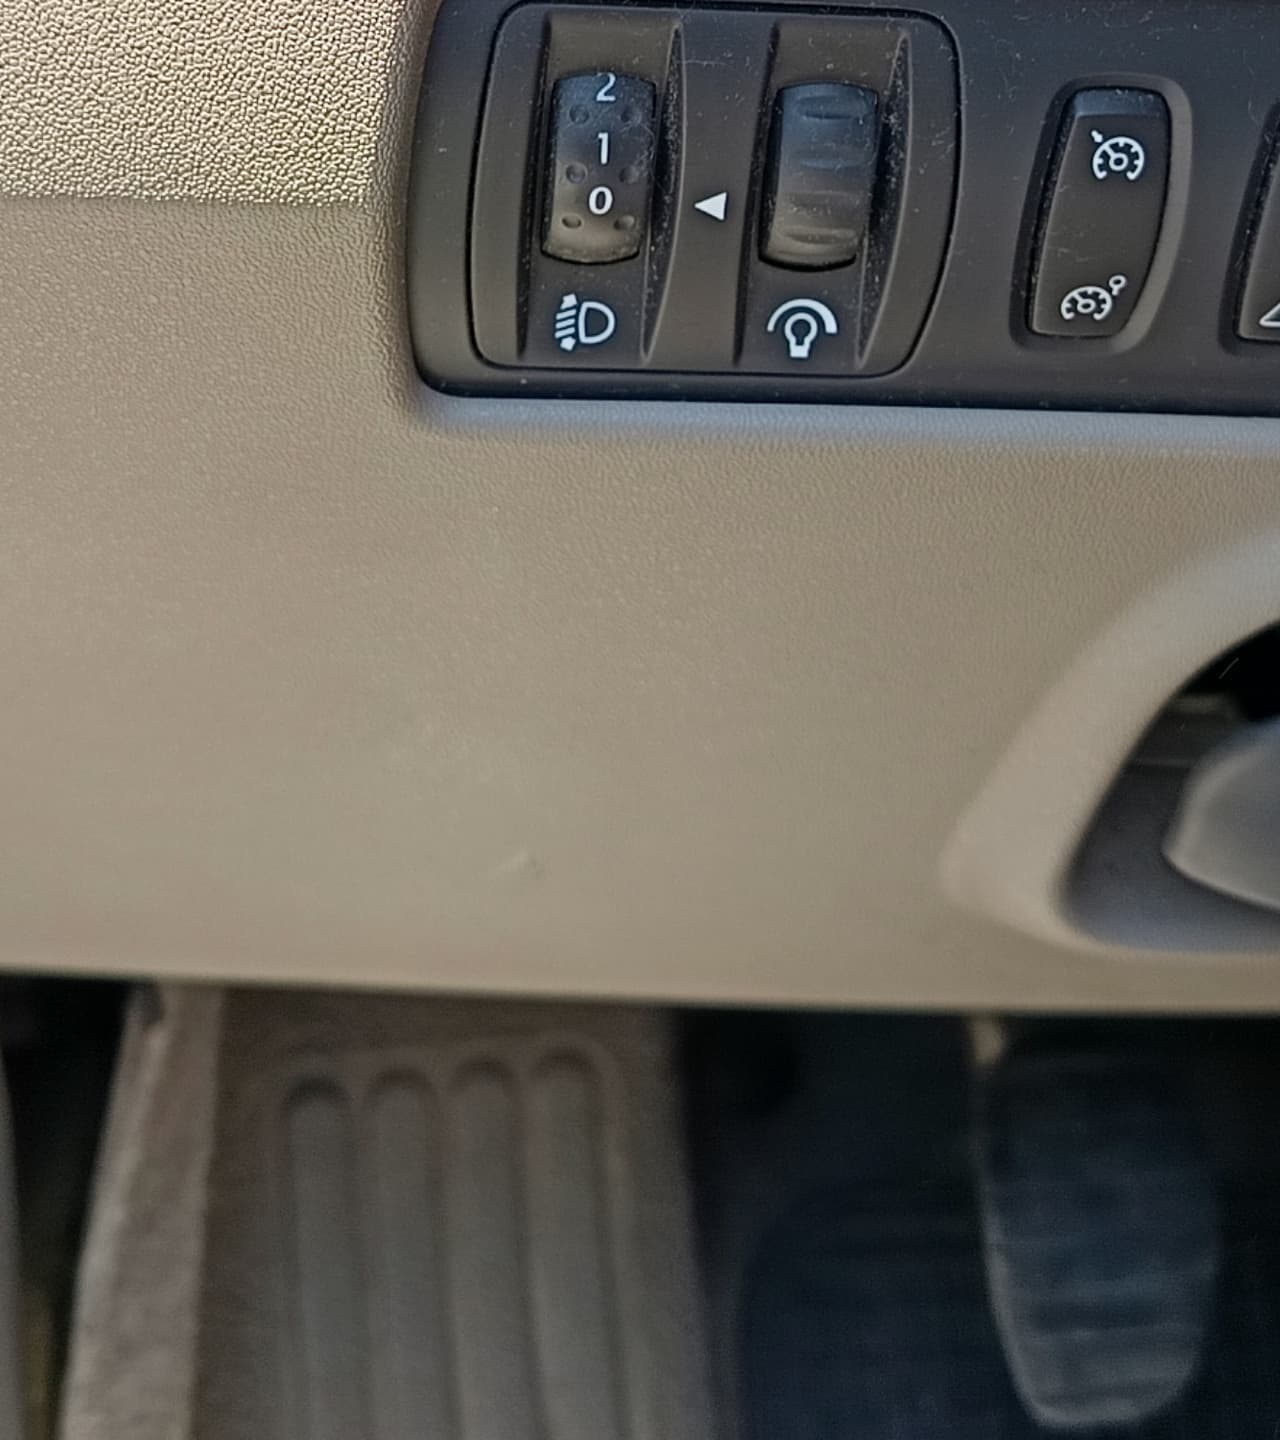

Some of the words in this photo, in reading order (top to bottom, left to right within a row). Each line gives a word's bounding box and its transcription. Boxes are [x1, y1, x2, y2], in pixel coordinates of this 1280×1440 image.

[596, 72, 616, 102] 2
[597, 132, 609, 164] 1
[587, 185, 614, 216] 0
